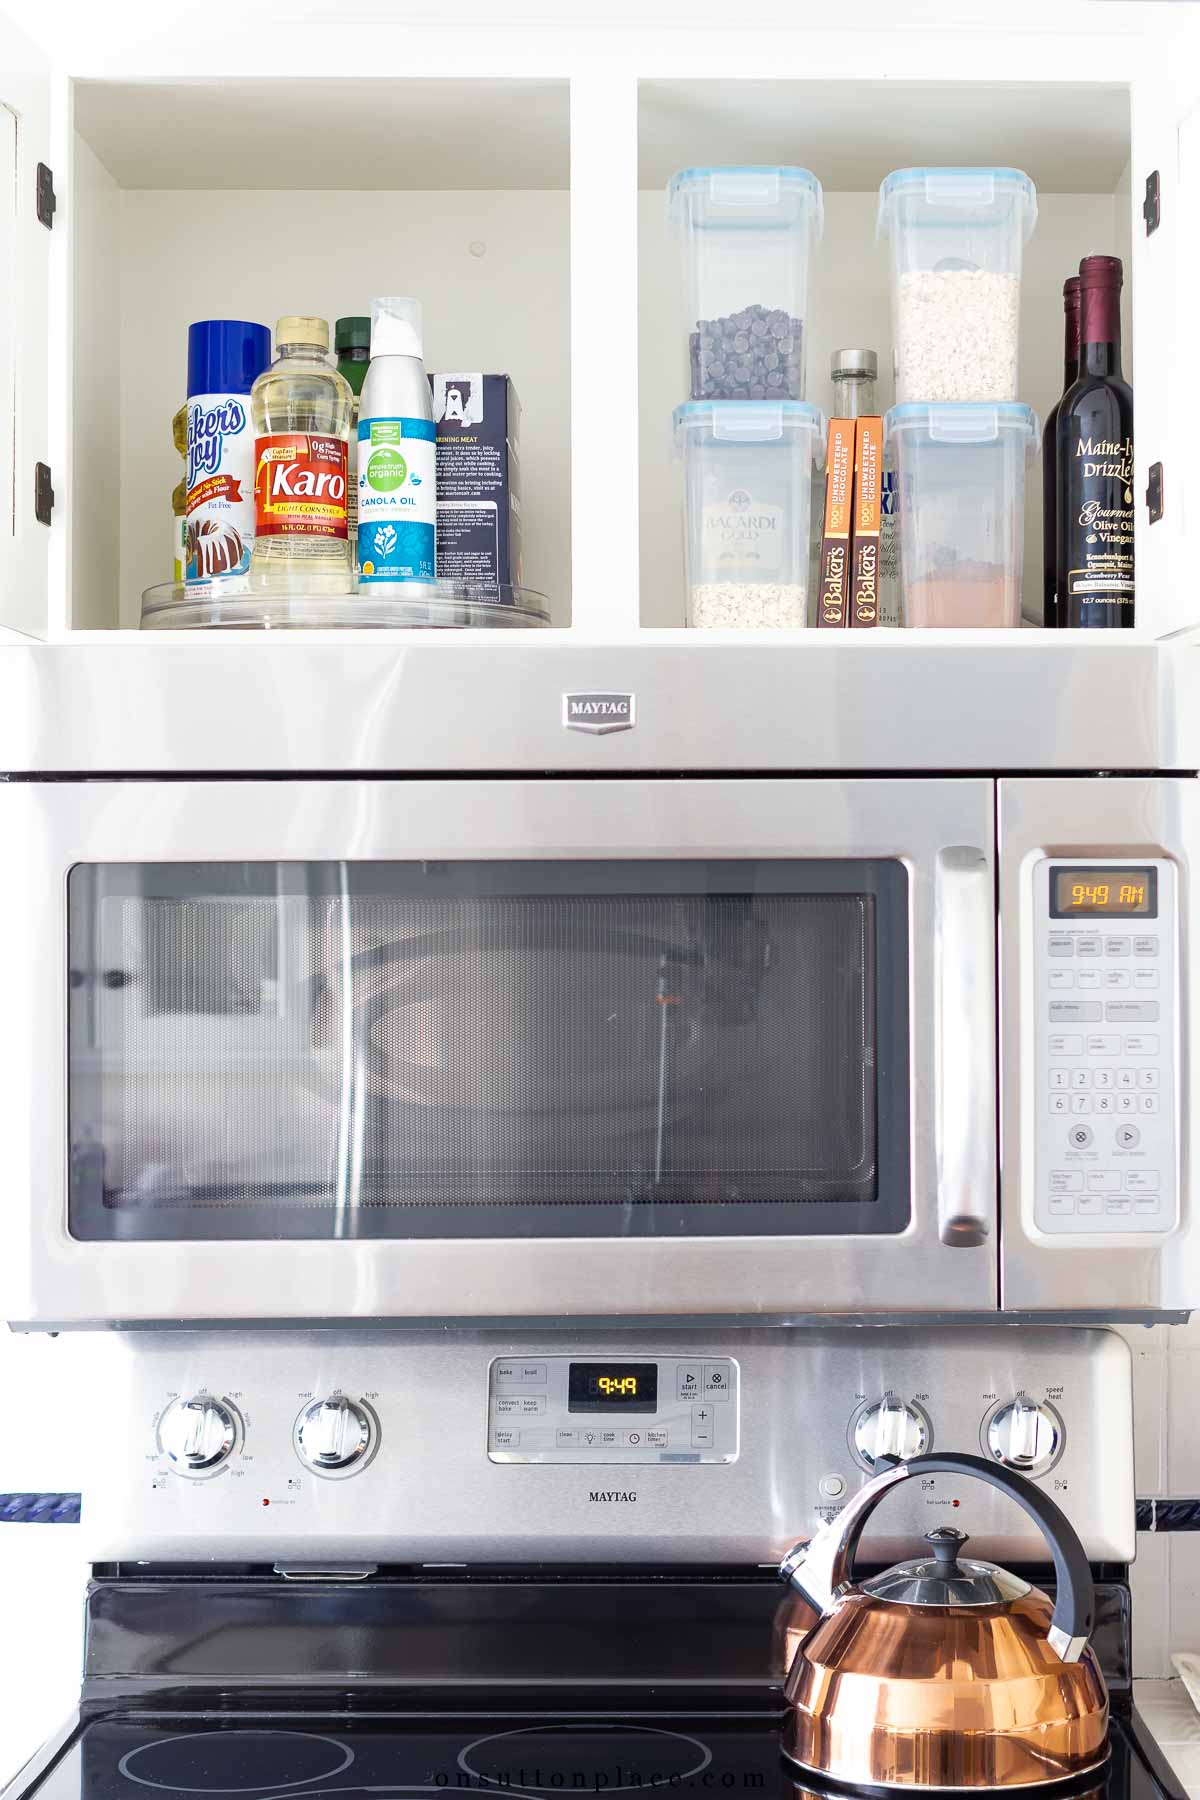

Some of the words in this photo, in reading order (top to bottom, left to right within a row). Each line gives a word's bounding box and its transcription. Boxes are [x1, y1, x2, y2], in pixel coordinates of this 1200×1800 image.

[311, 441, 325, 454] 0g
[831, 432, 842, 501] UNSWEETENED
[861, 431, 870, 500] UNSWEETENED
[369, 469, 404, 479] organic
[838, 447, 848, 503] CHOCOLATE
[868, 444, 877, 501] CHOCOLATE
[271, 463, 344, 500] Karo
[361, 497, 397, 507] CANOLA
[400, 497, 417, 505] OIL
[299, 505, 321, 513] CORN
[1092, 520, 1119, 530] Olive
[1120, 521, 1134, 531] Oil
[823, 546, 845, 607] Baker's
[856, 544, 876, 606] Baker's
[570, 702, 628, 714] MAYTAG
[1120, 885, 1144, 904] AM
[1056, 1098, 1063, 1109] 6
[1079, 1098, 1086, 1109] 7
[1100, 1098, 1108, 1109] 8
[1123, 1098, 1130, 1109] 9
[1145, 1098, 1152, 1109] 0
[598, 1377, 637, 1395] 9:49
[229, 1391, 243, 1399] high
[365, 1391, 379, 1400] high
[915, 1393, 930, 1401] high
[588, 1491, 637, 1502] MAYTAG
